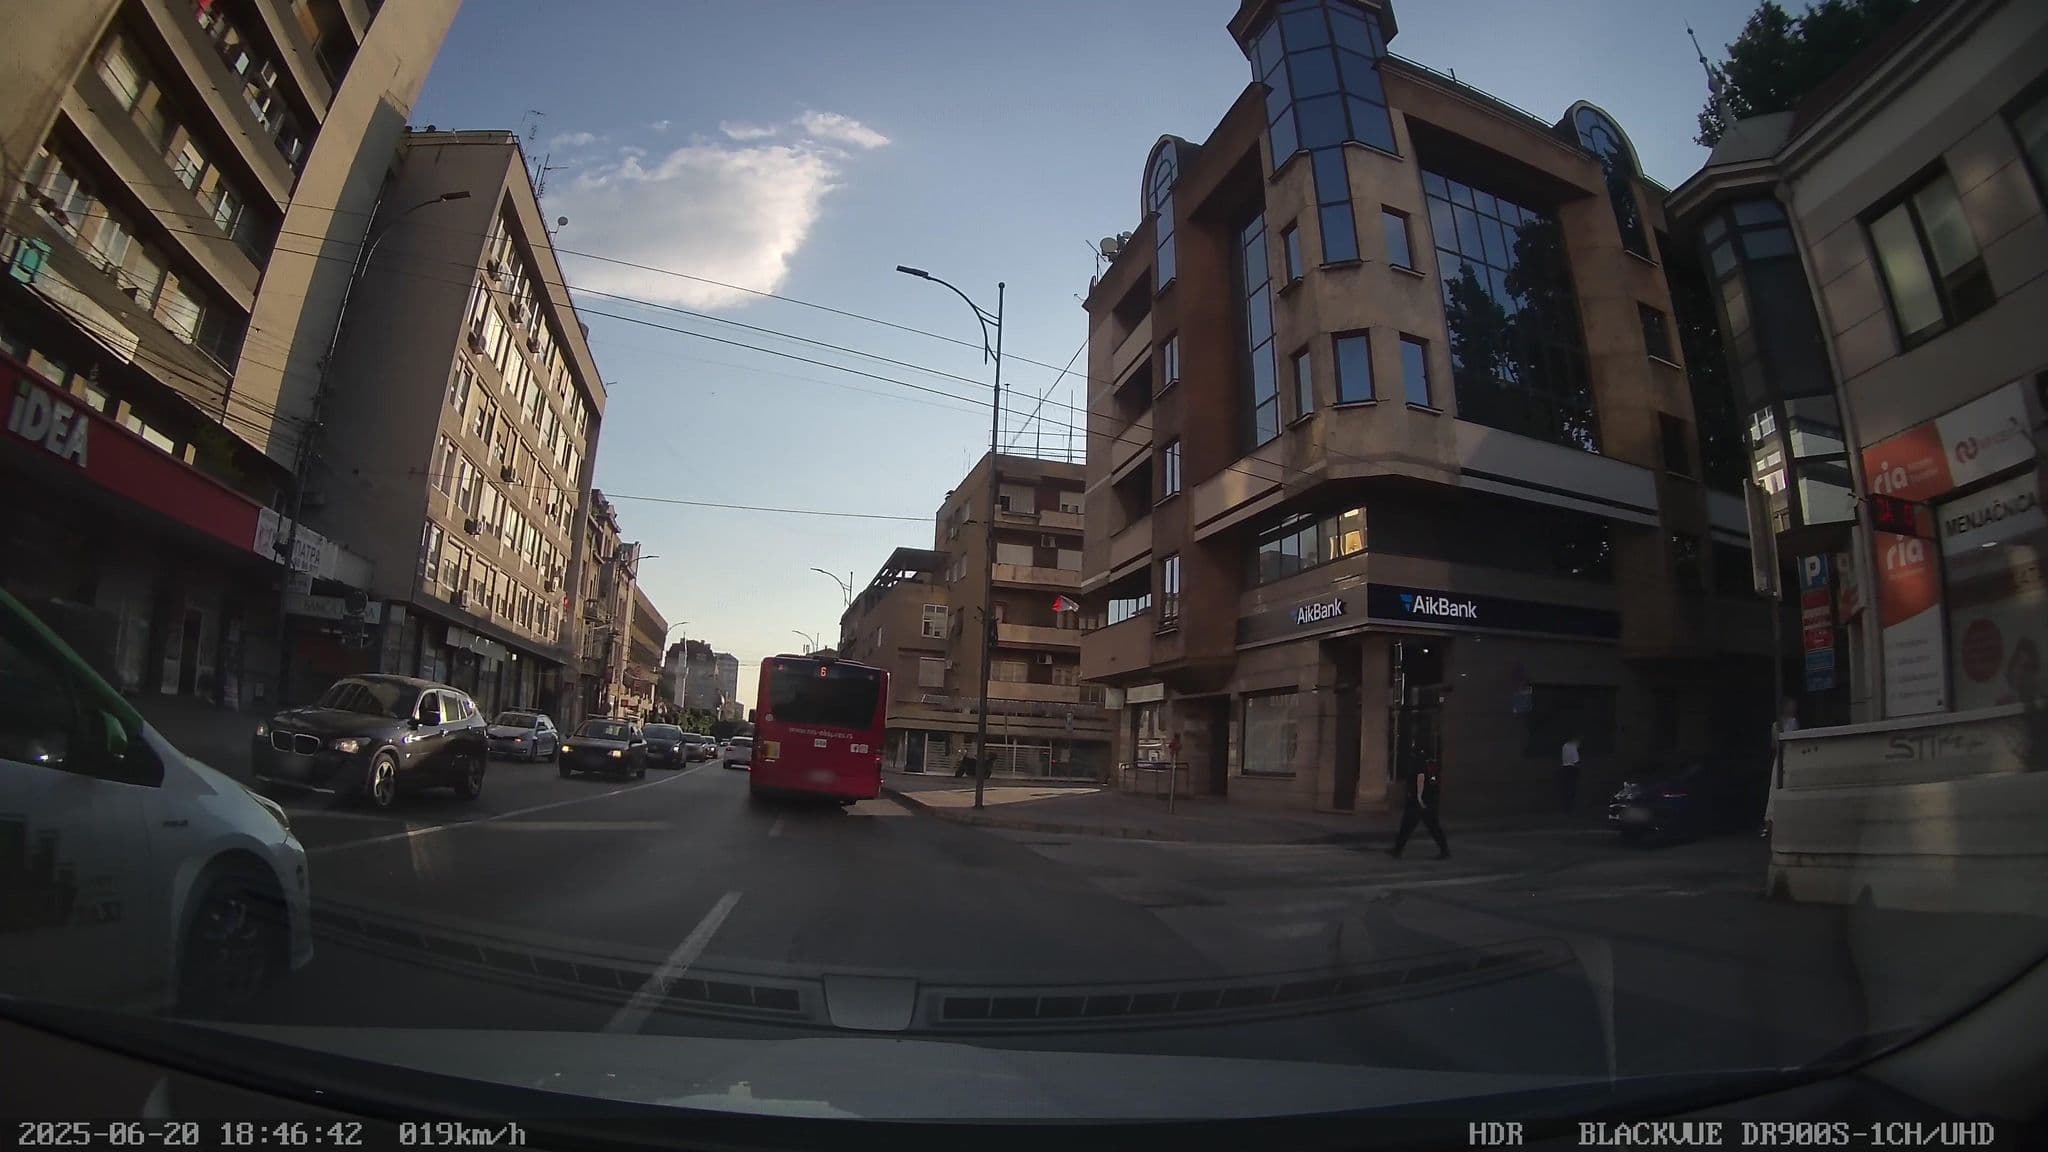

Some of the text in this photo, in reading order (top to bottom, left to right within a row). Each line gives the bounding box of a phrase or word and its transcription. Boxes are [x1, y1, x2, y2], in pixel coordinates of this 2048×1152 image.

[1874, 461, 1909, 494] ria
[1945, 491, 2037, 537] MENJAČNICA
[1887, 534, 1924, 570] ria
[1296, 599, 1343, 624] AikBank
[1413, 595, 1478, 618] AikBank
[820, 667, 827, 677] 6
